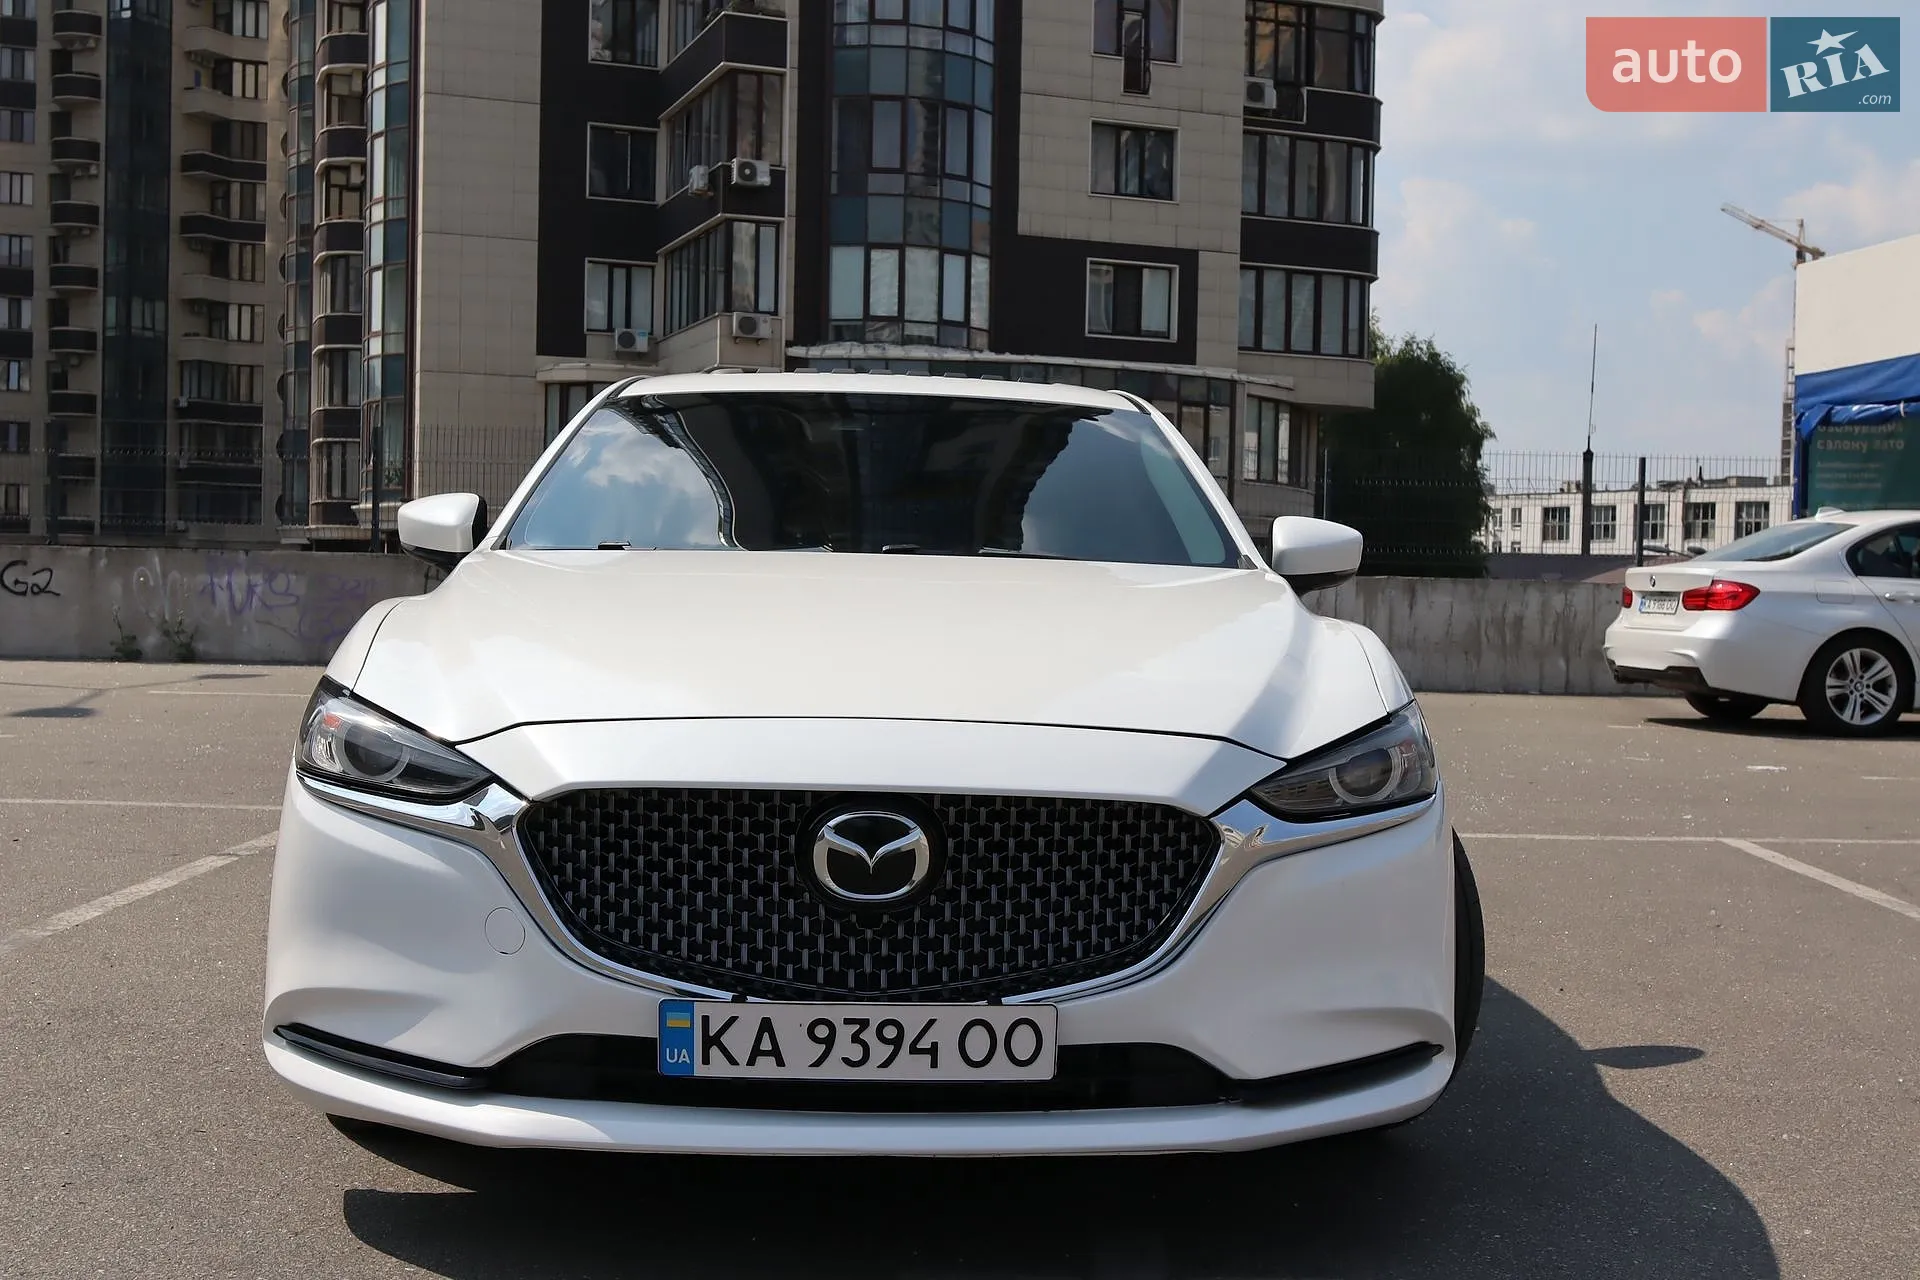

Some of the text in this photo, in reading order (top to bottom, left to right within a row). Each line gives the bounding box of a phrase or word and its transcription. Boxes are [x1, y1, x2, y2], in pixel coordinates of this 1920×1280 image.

[1817, 439, 1868, 453] салону
[0, 560, 60, 597] G2
[701, 1015, 1043, 1069] KA 9394 OO
[666, 1048, 690, 1064] UA
